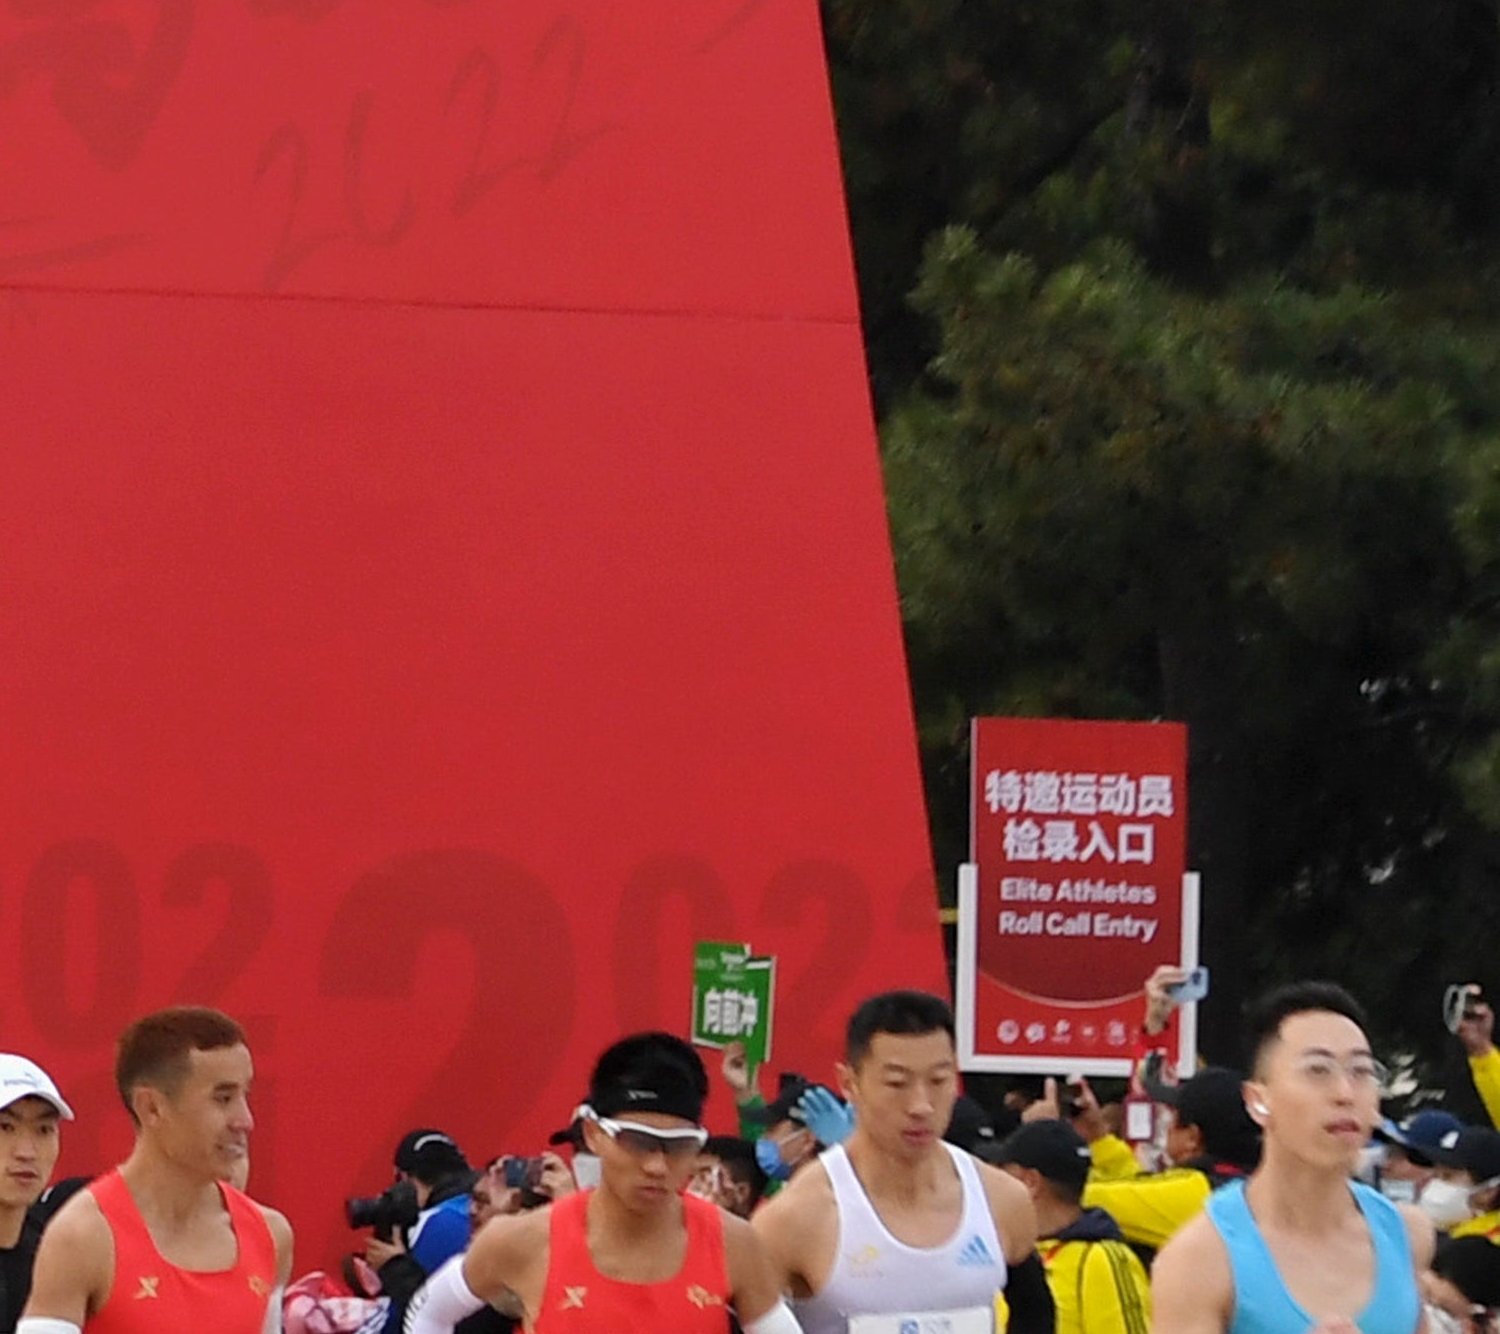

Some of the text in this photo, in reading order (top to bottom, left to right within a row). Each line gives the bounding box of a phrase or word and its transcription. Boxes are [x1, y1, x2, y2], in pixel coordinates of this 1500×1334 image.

[986, 771, 1174, 817] 特邀运动员
[1003, 820, 1154, 864] 检录入口
[1001, 879, 1156, 904] Elite Athletes
[1000, 912, 1158, 943] Roll Call Entry
